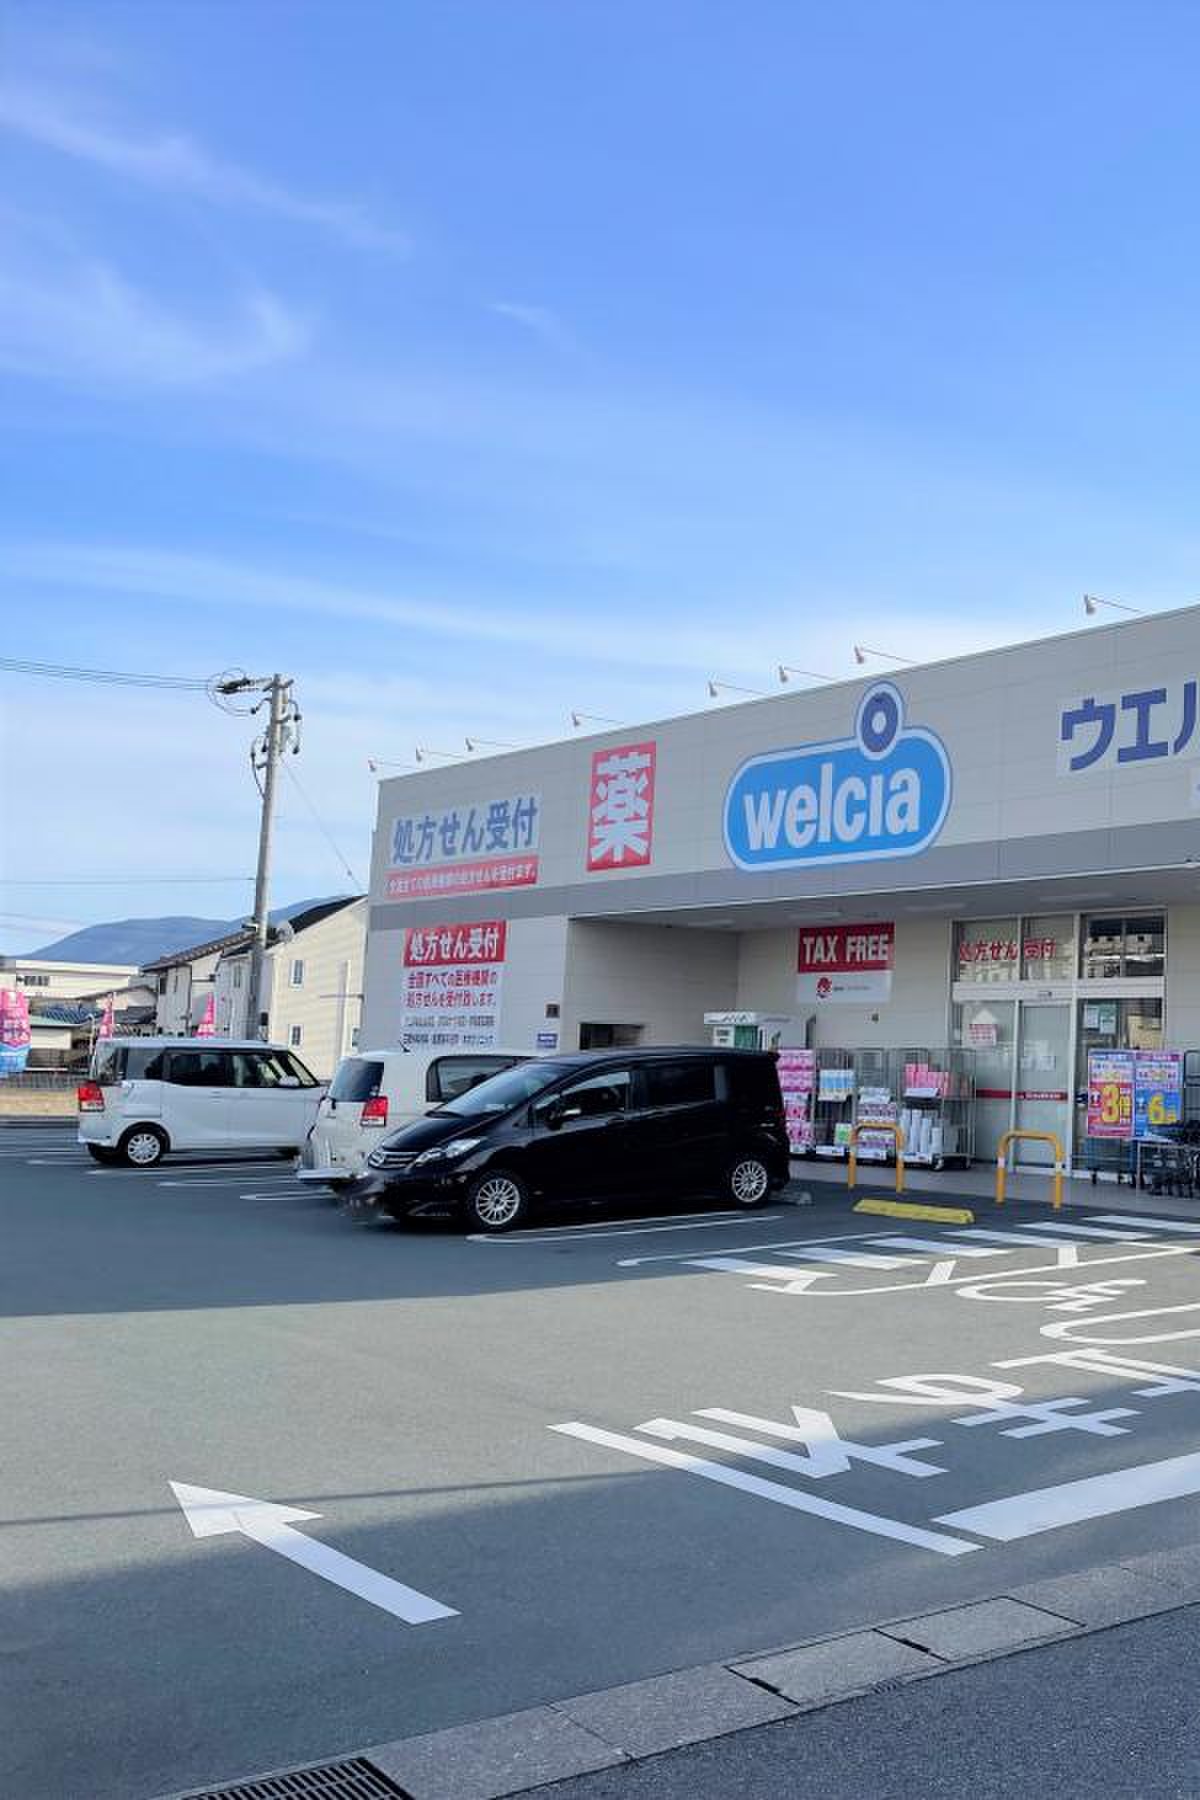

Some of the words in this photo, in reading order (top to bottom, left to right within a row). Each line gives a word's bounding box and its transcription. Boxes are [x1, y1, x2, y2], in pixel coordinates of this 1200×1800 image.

[392, 797, 537, 864] 処方せん受付
[590, 751, 650, 863] 薬
[744, 762, 921, 851] welcia
[410, 926, 499, 961] 処方せん受付
[803, 935, 838, 964] TAX
[846, 932, 890, 962] FREE
